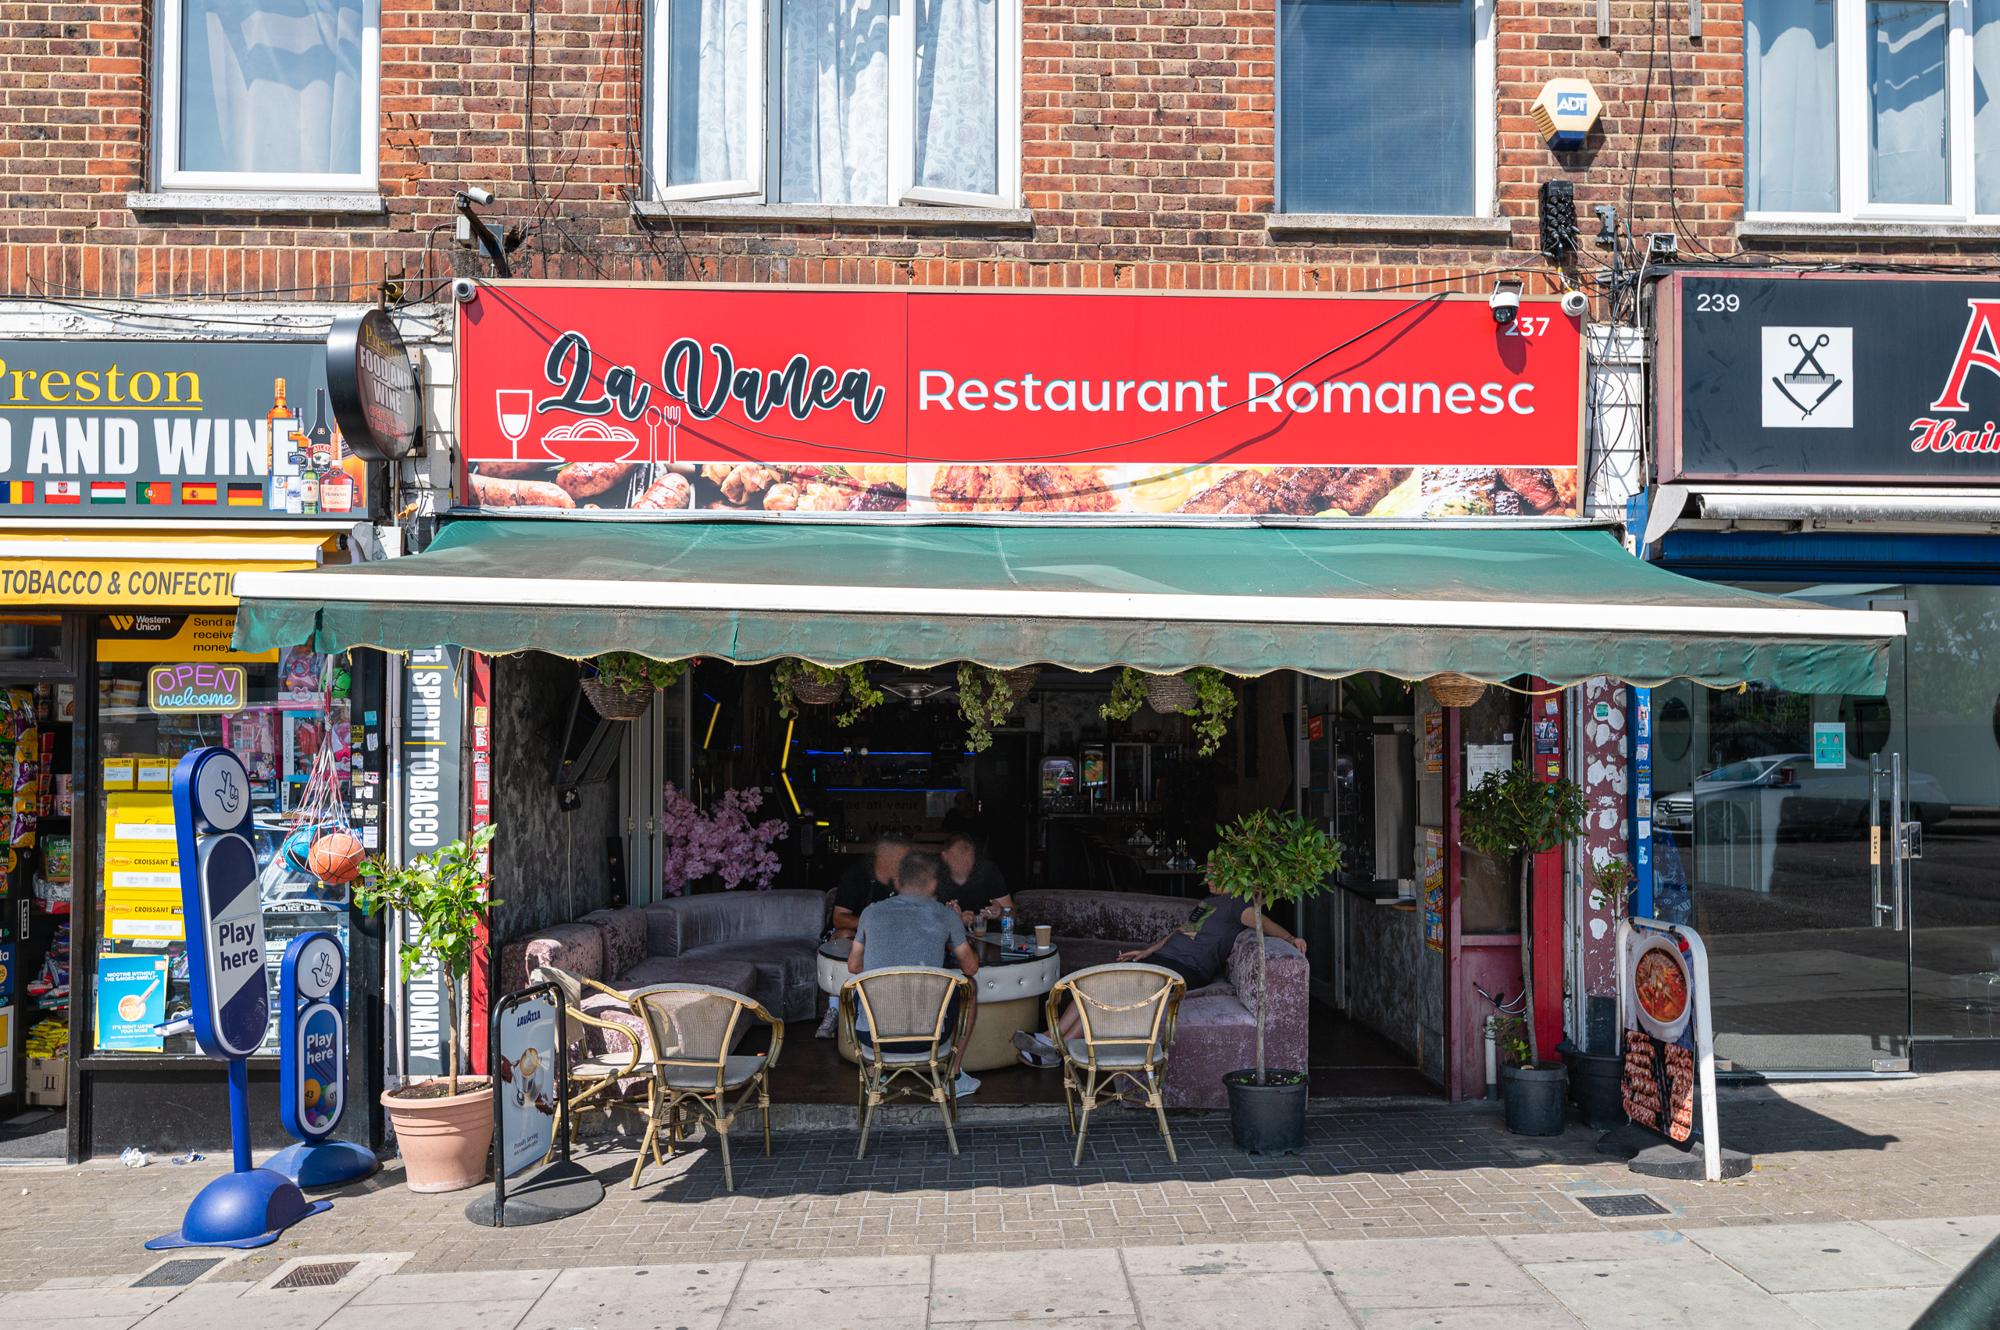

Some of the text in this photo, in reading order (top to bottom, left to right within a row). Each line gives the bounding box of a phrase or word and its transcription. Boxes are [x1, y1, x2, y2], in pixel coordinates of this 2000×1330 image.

[1557, 97, 1587, 111] ADT
[1697, 294, 1740, 312] 239
[1505, 317, 1550, 336] 237
[0, 358, 203, 403] reston
[360, 345, 411, 394] FOOD AND
[536, 330, 886, 424] La Vanea
[373, 380, 402, 414] WINE
[919, 370, 1535, 414] Restaurant Romanesc
[26, 417, 139, 475] AND
[153, 418, 300, 476] WINE
[2, 570, 101, 594] TOBACCO
[107, 571, 121, 595] &
[136, 615, 171, 624] Western
[136, 624, 161, 632] Union
[194, 618, 223, 627] Send
[193, 645, 230, 654] money
[156, 665, 237, 692] OPEN
[159, 686, 236, 706] welcome
[411, 672, 442, 741] SPIRIT
[409, 749, 440, 847] TOBACCO
[219, 922, 256, 947] Play
[220, 948, 259, 972] here
[517, 1010, 540, 1027] LAVAZZA
[306, 1033, 334, 1048] Play
[306, 1049, 334, 1064] here
[305, 1090, 314, 1099] 43
